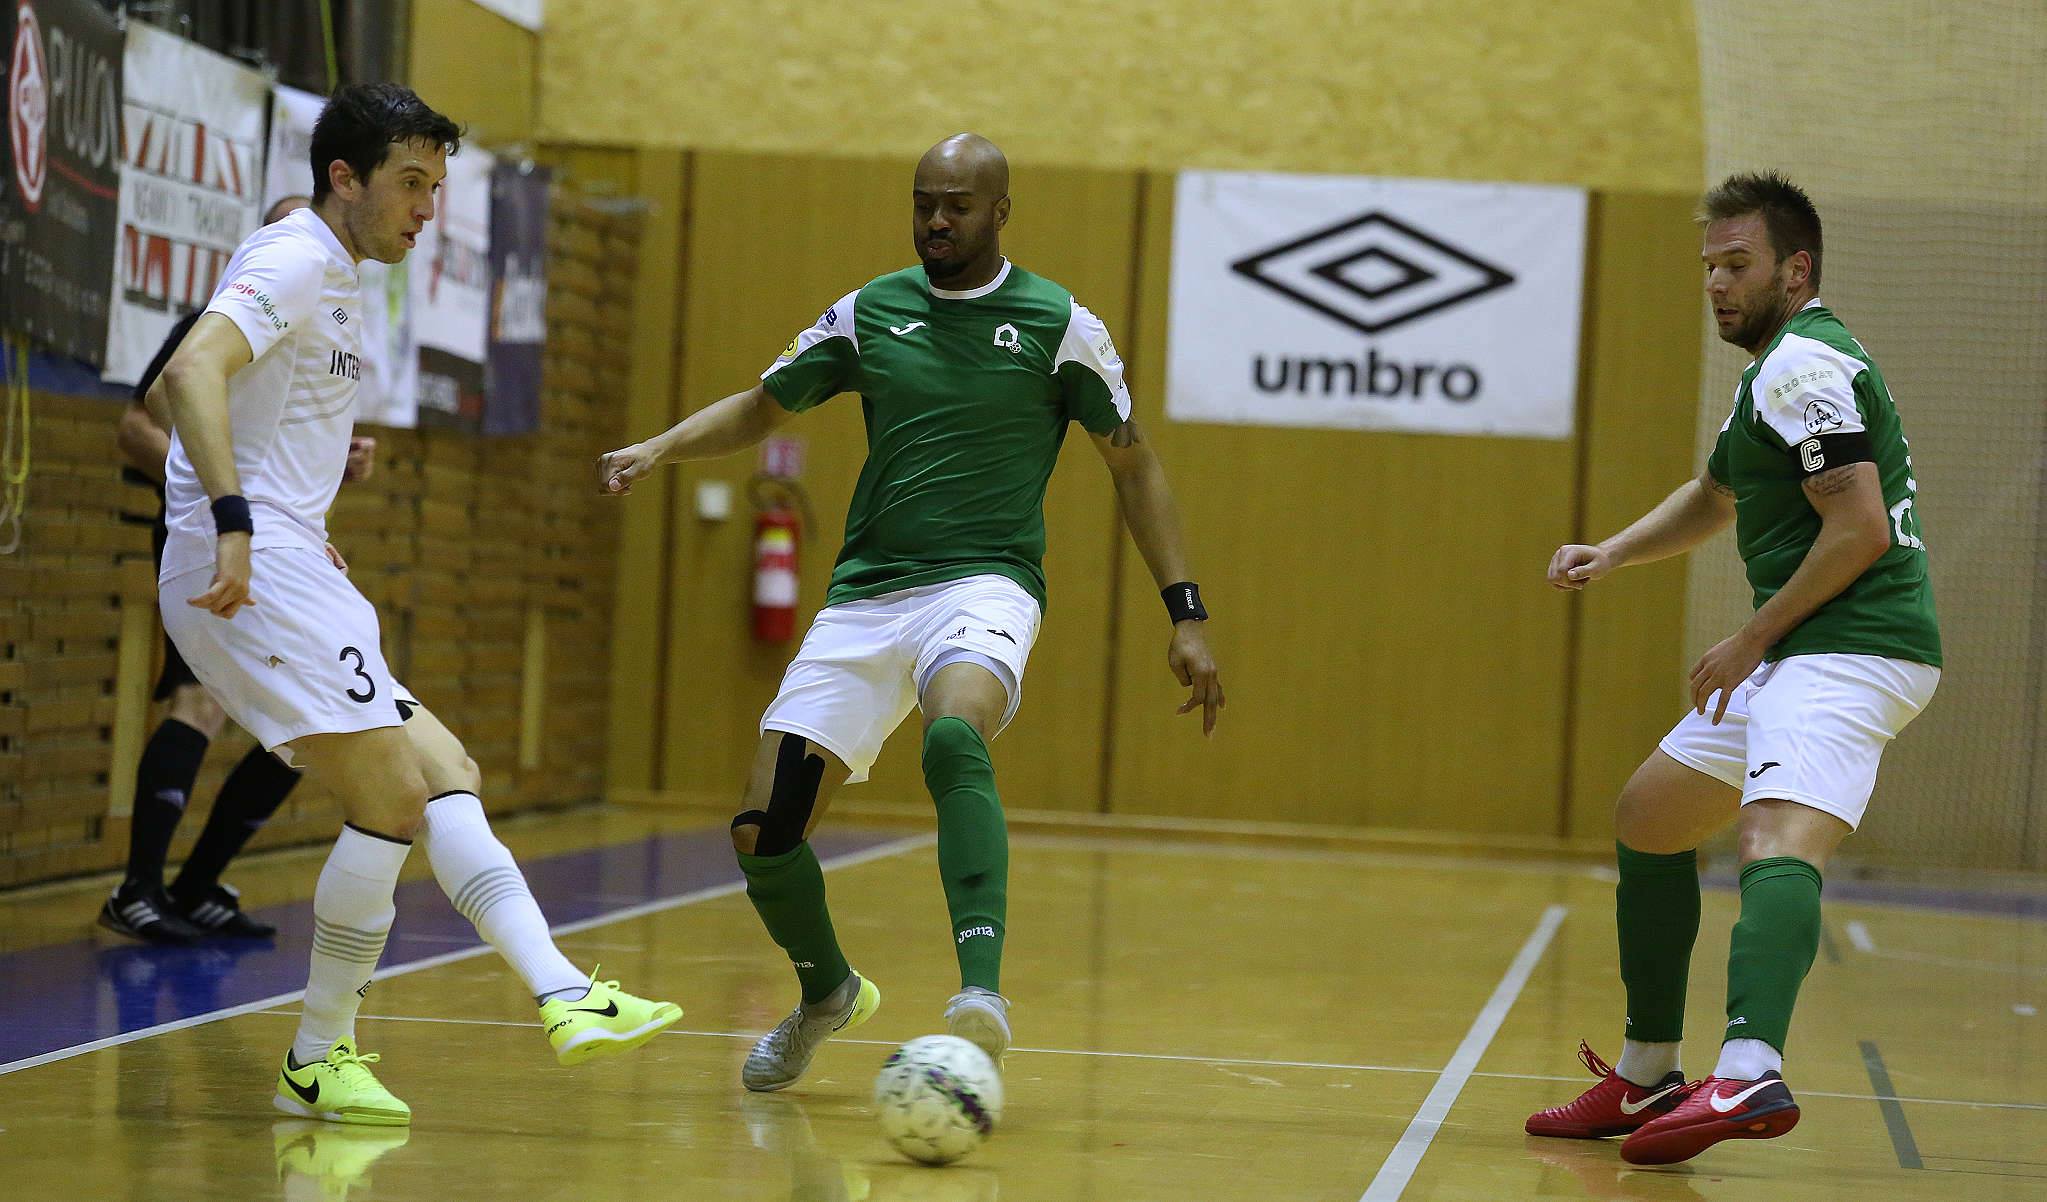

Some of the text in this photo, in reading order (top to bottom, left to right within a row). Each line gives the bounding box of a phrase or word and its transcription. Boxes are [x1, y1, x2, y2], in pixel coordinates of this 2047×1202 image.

[1254, 347, 1482, 402] umbro
[1800, 439, 1825, 472] C
[339, 646, 375, 703] 3
